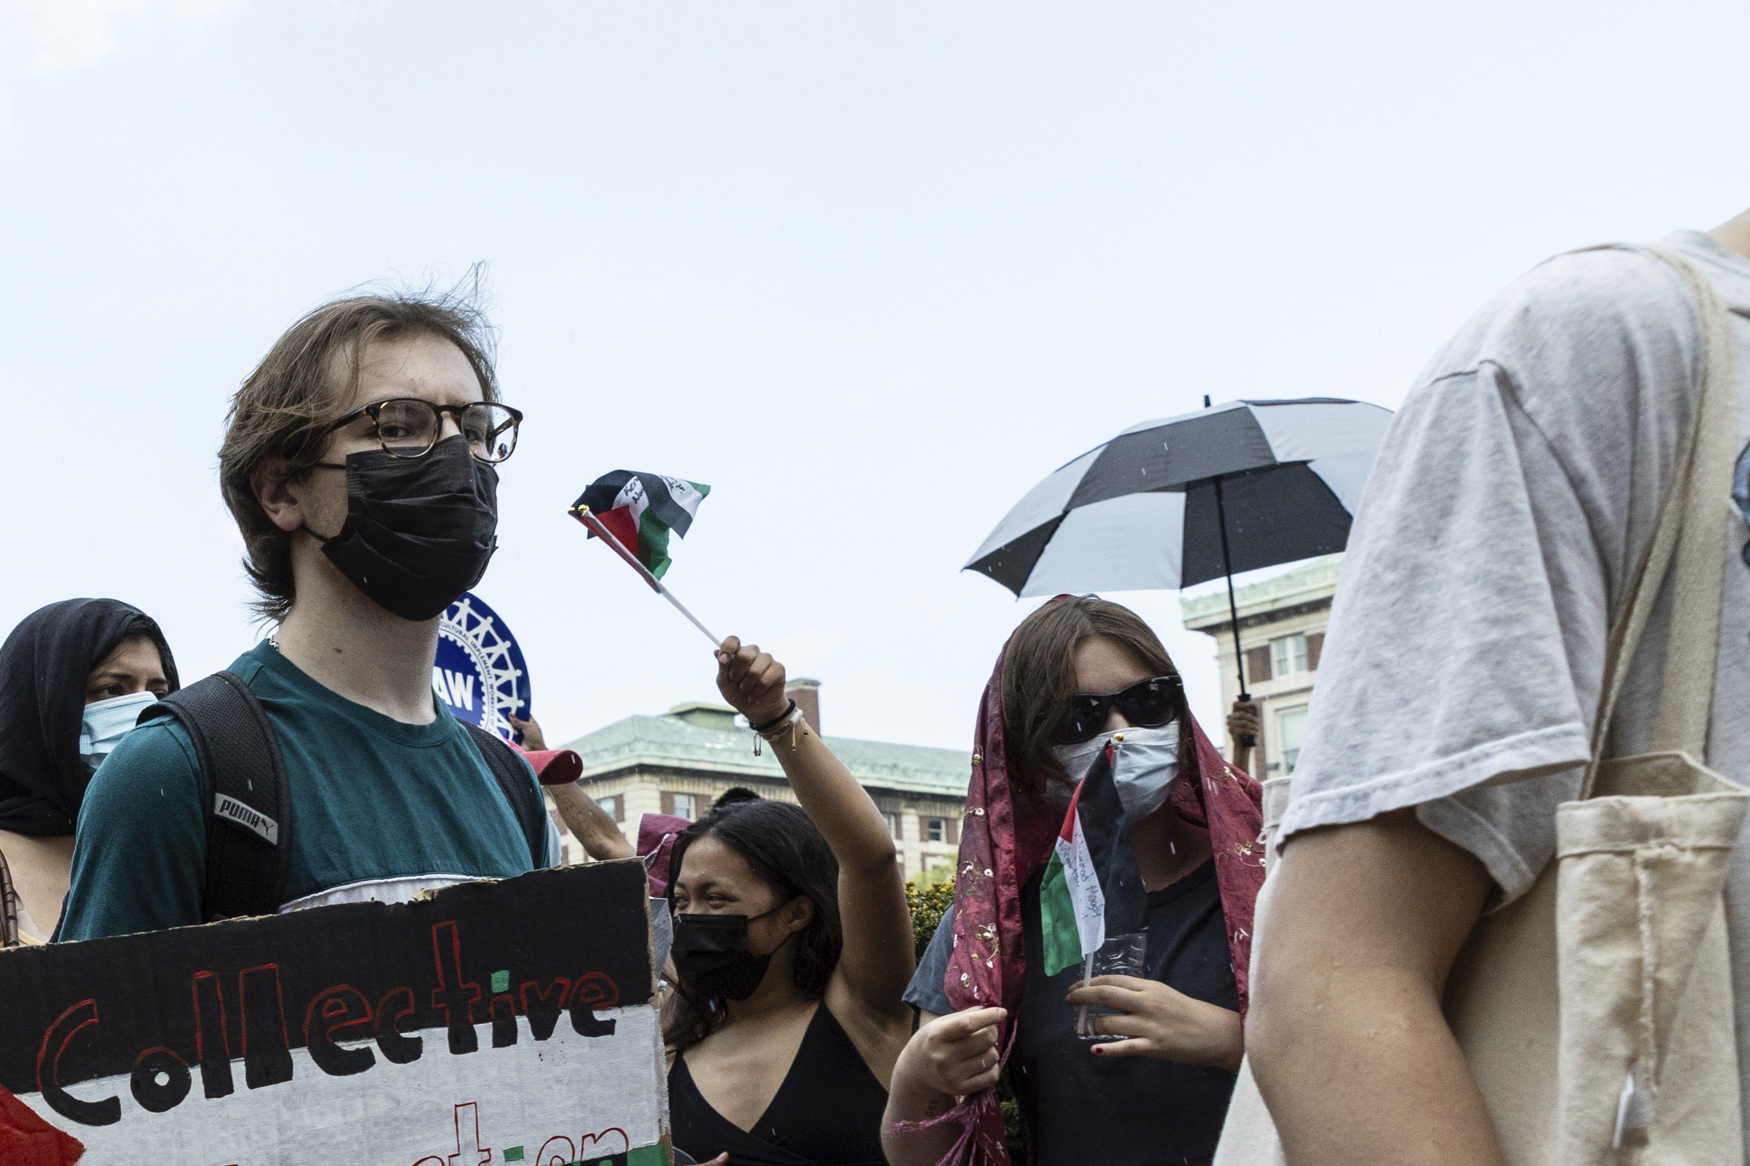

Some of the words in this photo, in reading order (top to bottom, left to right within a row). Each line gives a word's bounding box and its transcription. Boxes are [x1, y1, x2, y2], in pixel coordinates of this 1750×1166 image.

[440, 621, 469, 641] CULTURAL
[470, 640, 493, 679] IMPLEMENT
[432, 666, 474, 712] AW
[219, 799, 261, 828] PUMA
[37, 920, 619, 1126] Collective
